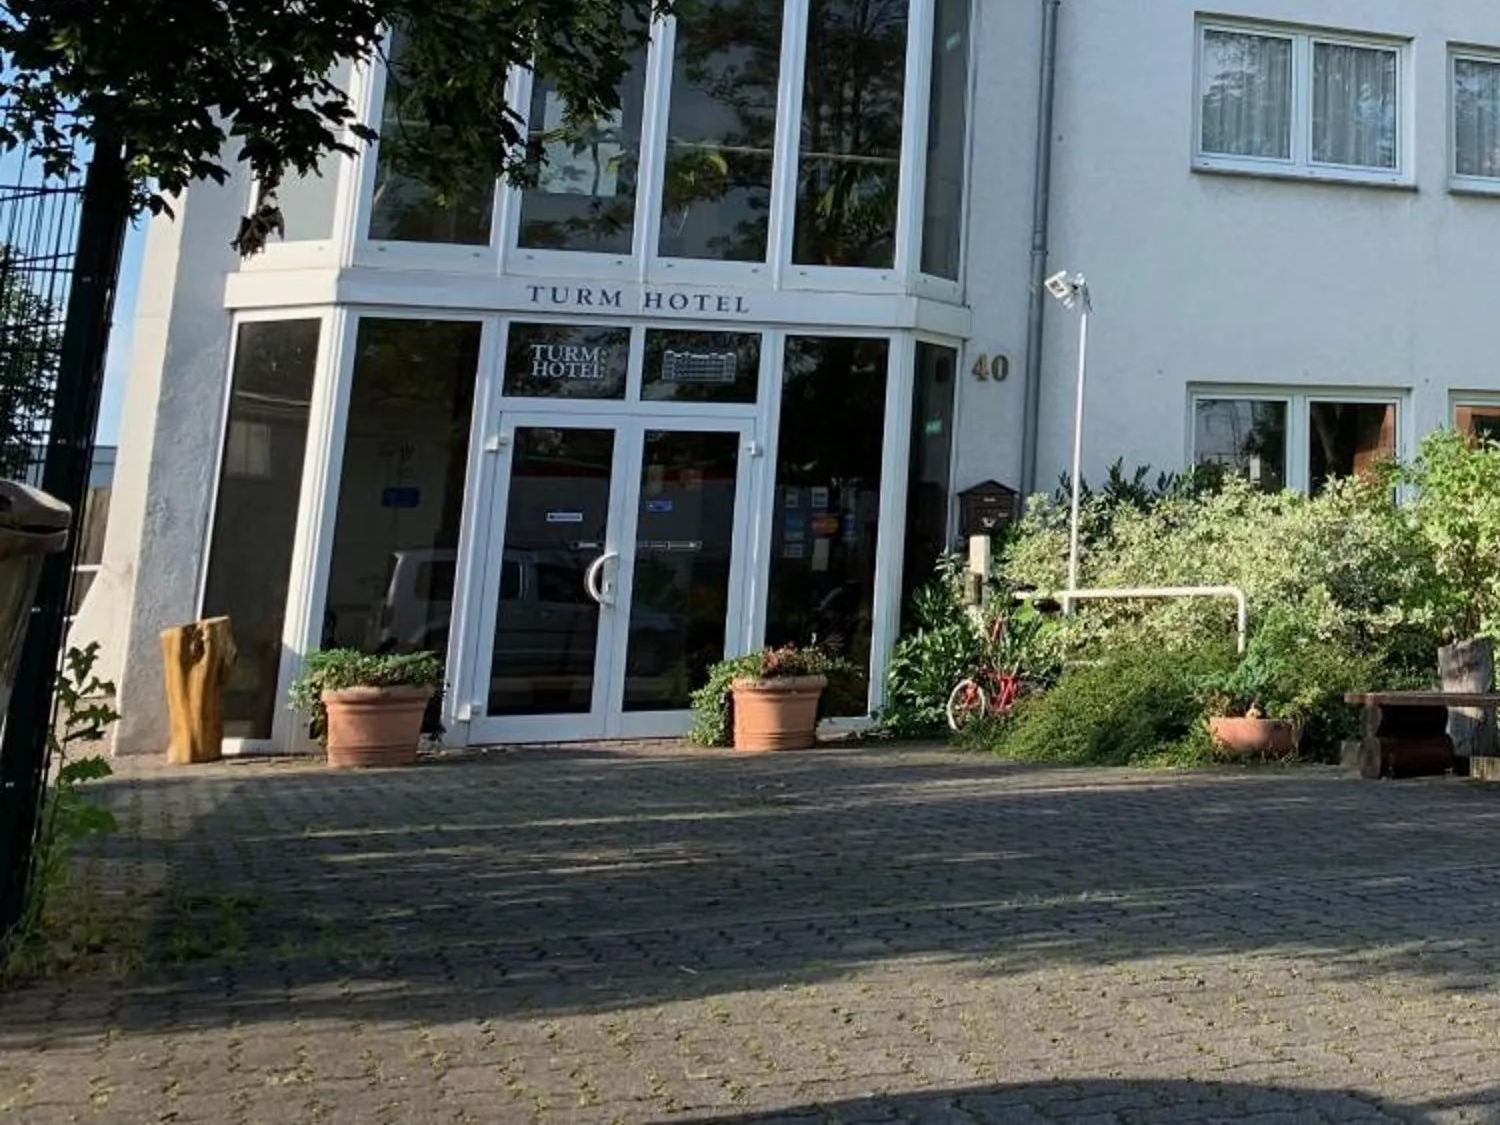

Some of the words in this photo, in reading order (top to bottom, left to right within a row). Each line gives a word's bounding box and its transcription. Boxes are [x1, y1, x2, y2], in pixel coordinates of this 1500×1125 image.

[526, 285, 622, 308] TURM
[643, 291, 750, 314] HOTEL
[530, 344, 602, 362] TURM
[531, 361, 602, 379] HOTEL
[971, 353, 1009, 382] 40
